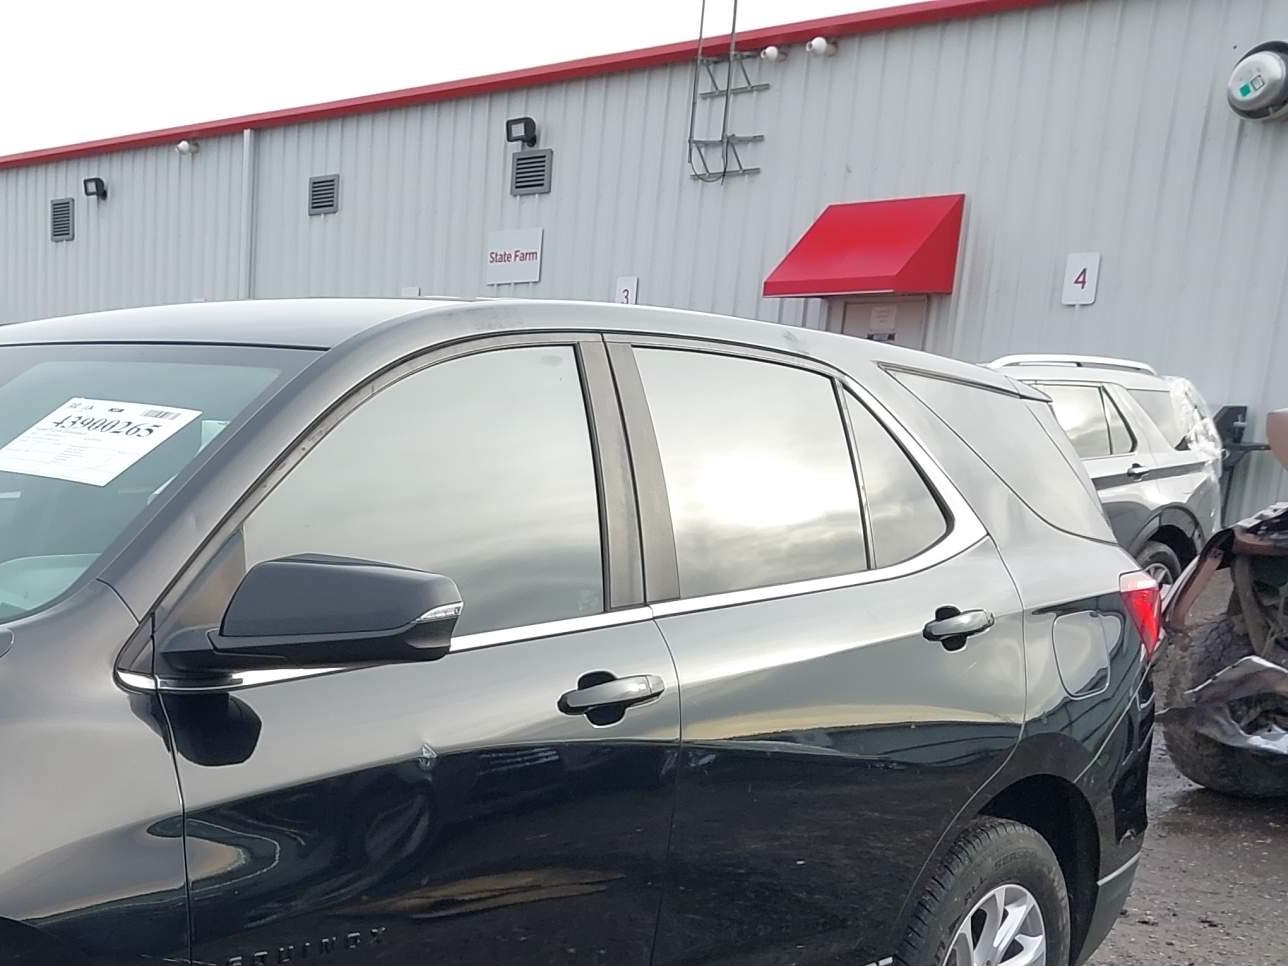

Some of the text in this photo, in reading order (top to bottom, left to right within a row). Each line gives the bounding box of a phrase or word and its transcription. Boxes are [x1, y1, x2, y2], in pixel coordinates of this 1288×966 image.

[489, 250, 538, 264] State Farm
[1073, 267, 1088, 290] 4
[622, 288, 630, 304] 3
[52, 414, 163, 438] 43900265
